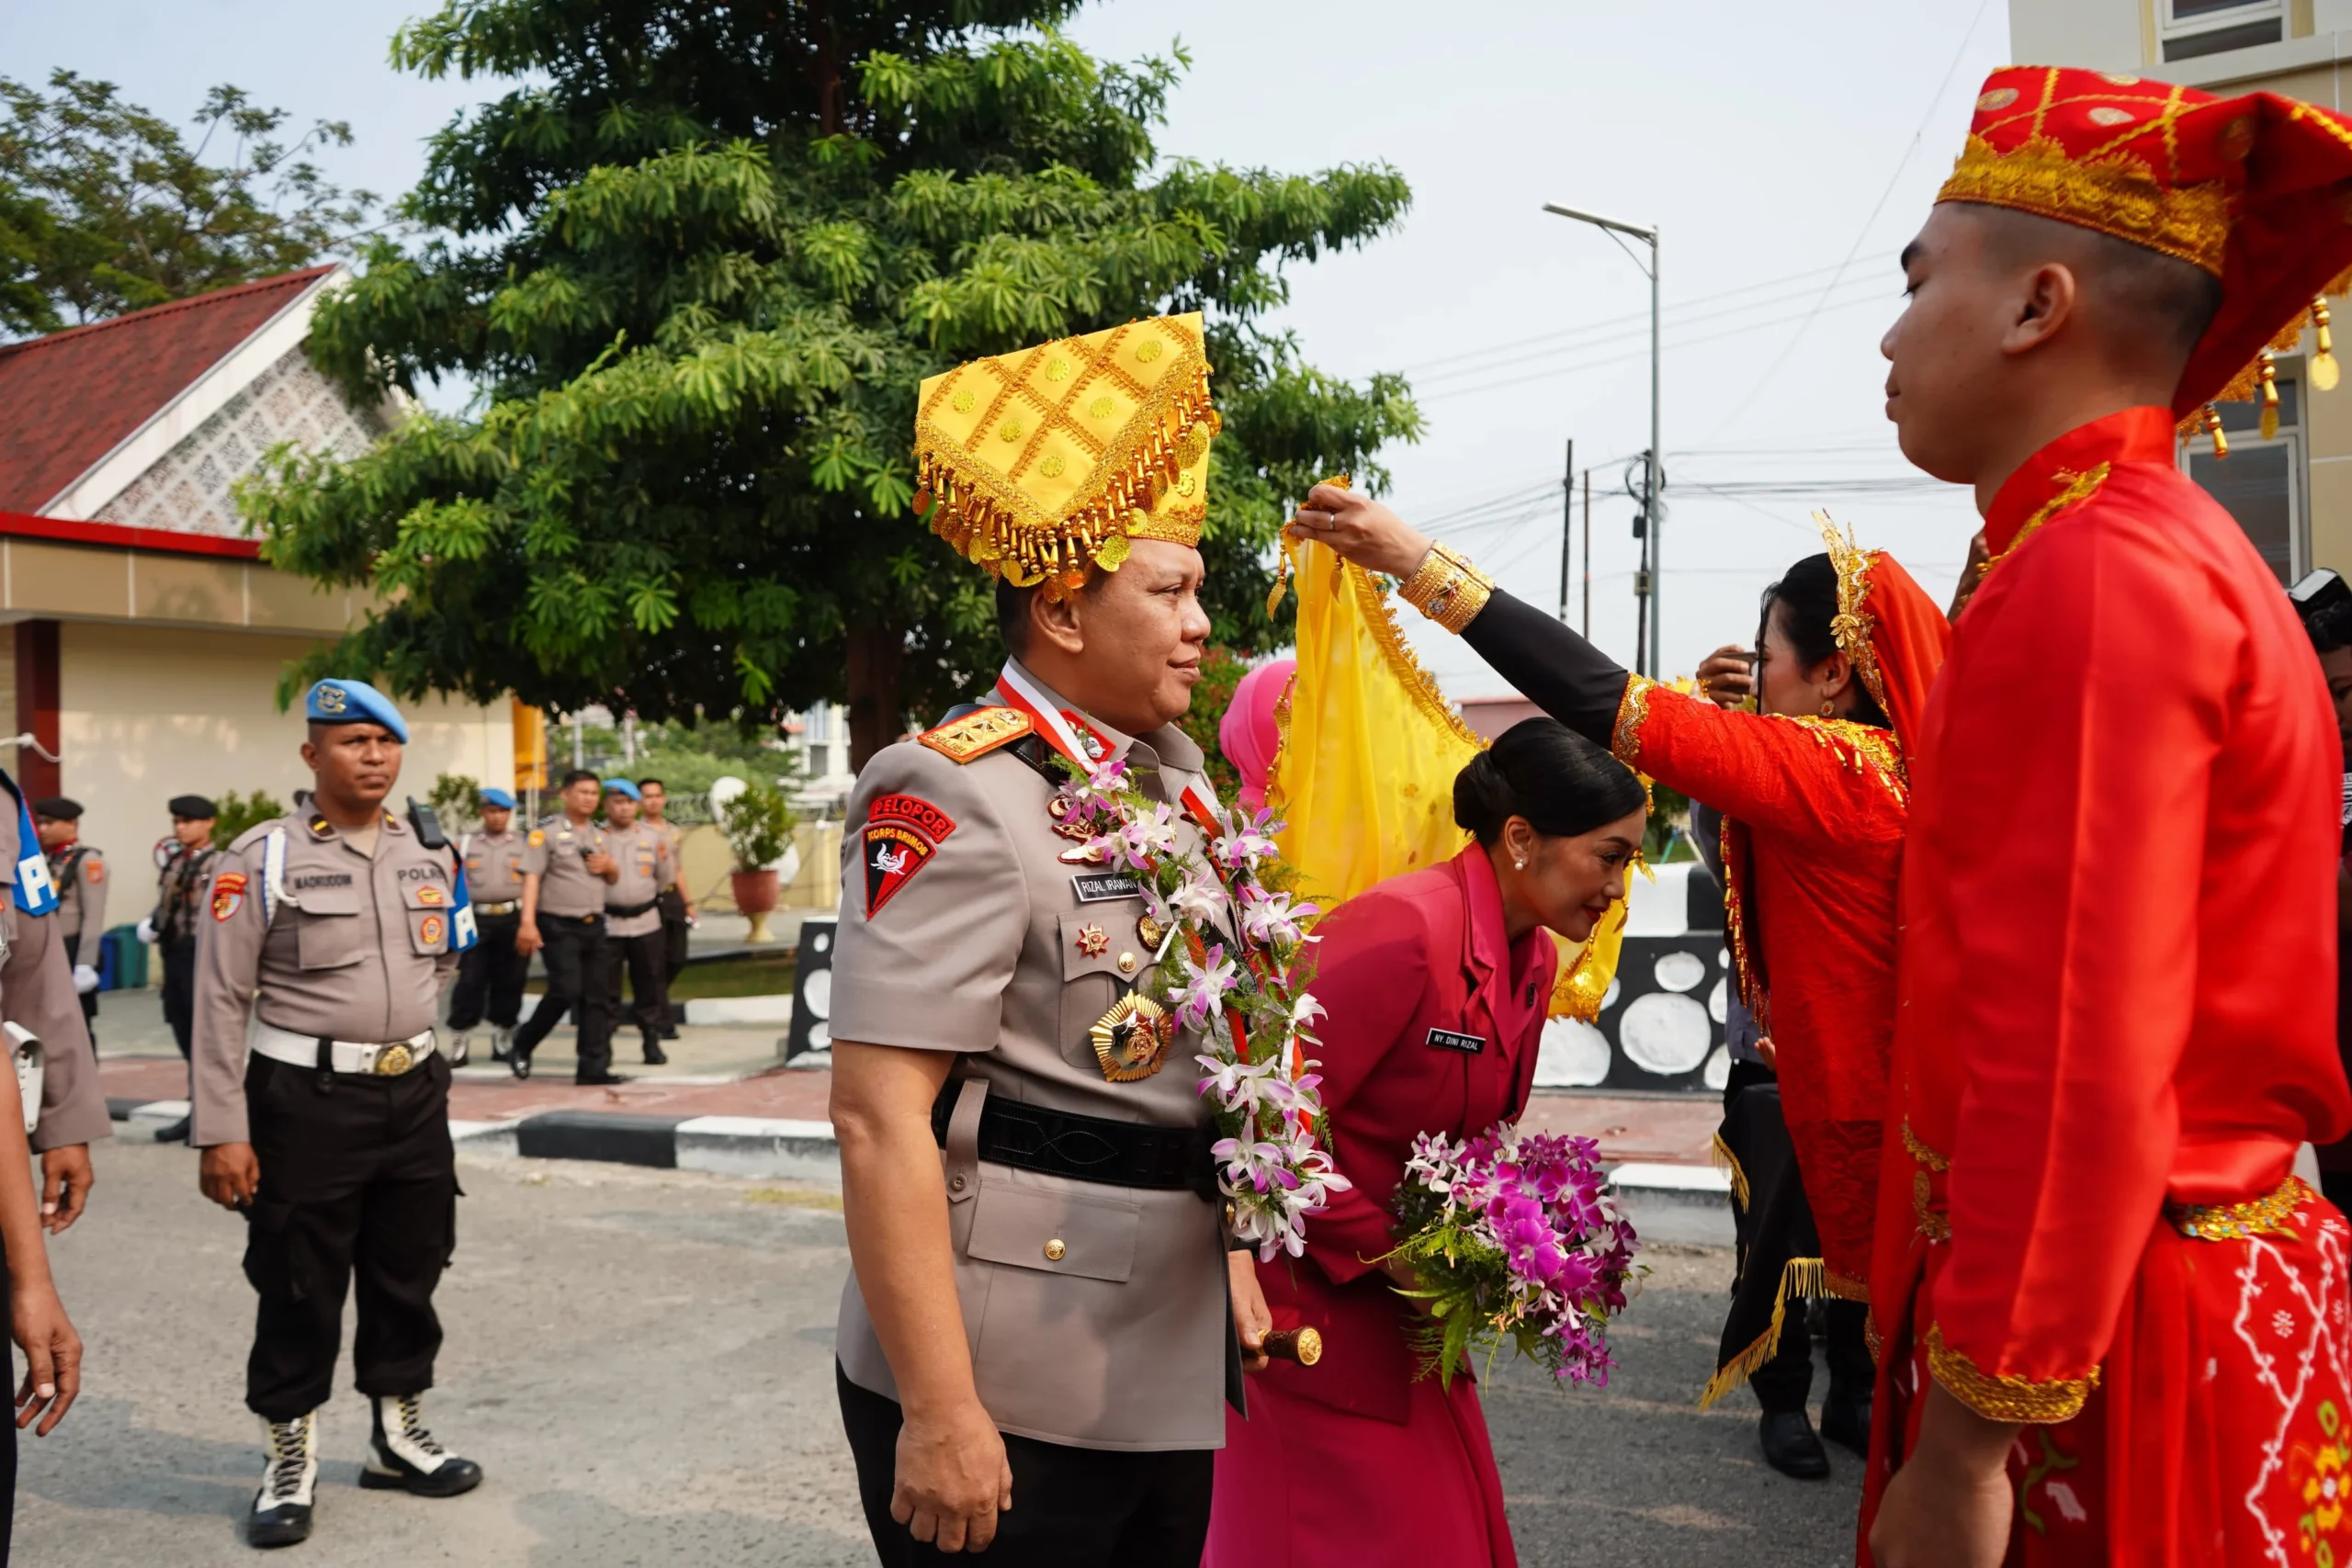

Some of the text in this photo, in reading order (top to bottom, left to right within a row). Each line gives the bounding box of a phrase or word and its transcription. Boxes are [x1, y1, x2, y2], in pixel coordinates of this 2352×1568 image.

[869, 798, 947, 836] PELOPOR
[867, 827, 929, 857] KORPS BRIMOB
[1080, 877, 1138, 894] RIZAL IRAWAN
[1433, 1033, 1478, 1051] NY. DINI RIZAL
